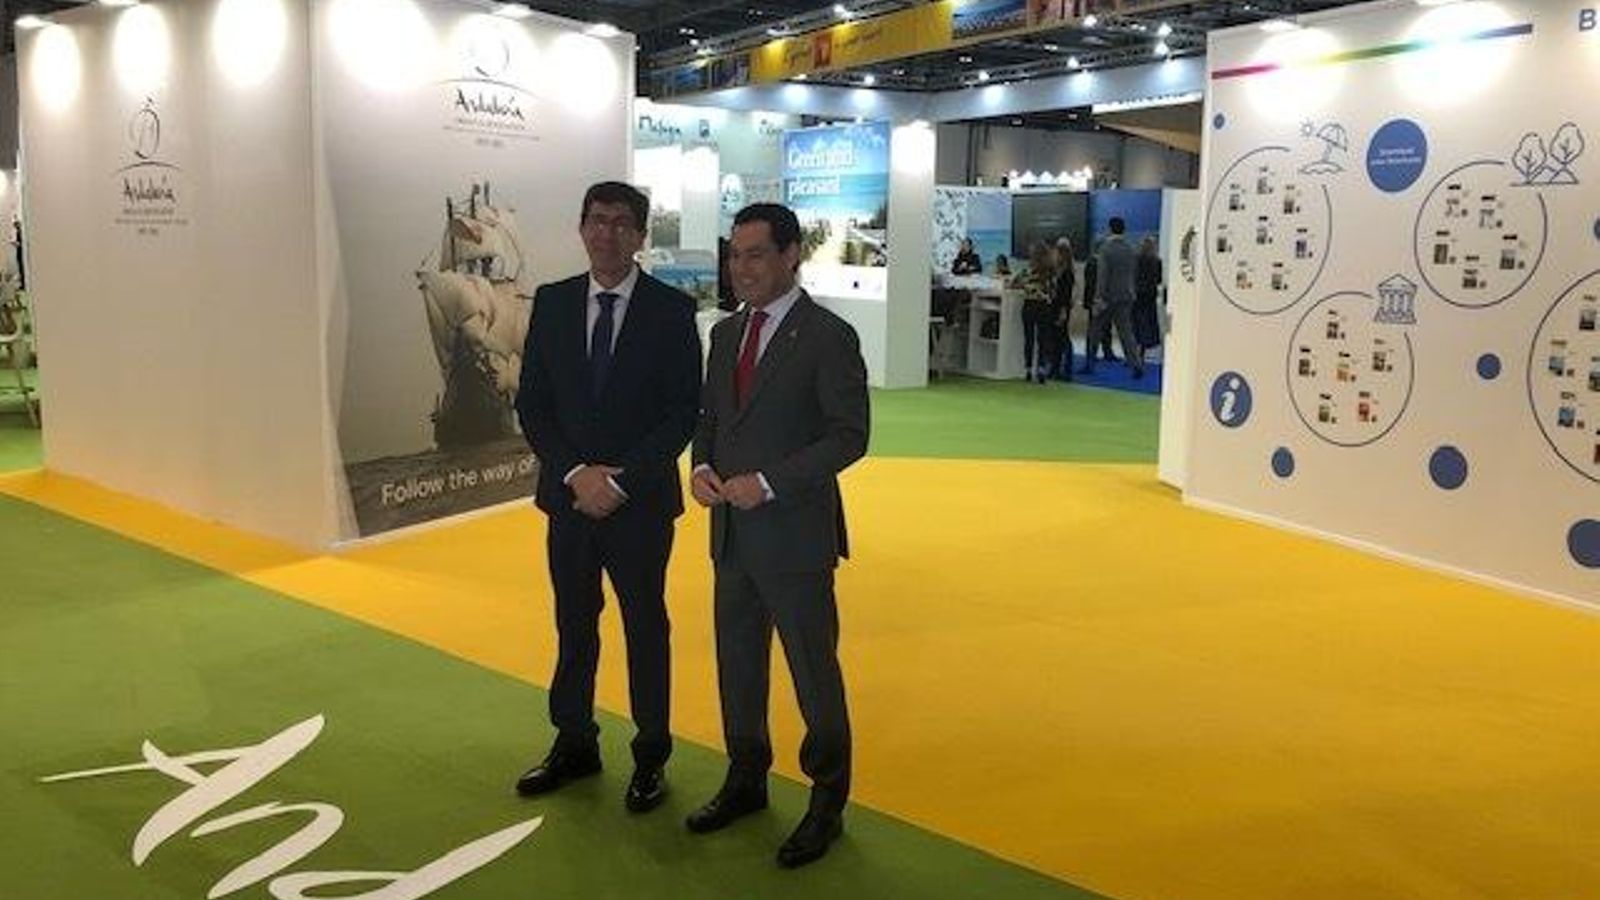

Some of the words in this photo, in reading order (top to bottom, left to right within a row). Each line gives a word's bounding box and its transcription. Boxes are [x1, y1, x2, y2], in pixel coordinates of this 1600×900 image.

[381, 476, 445, 506] Follow
[450, 468, 478, 491] the
[481, 461, 515, 483] way
